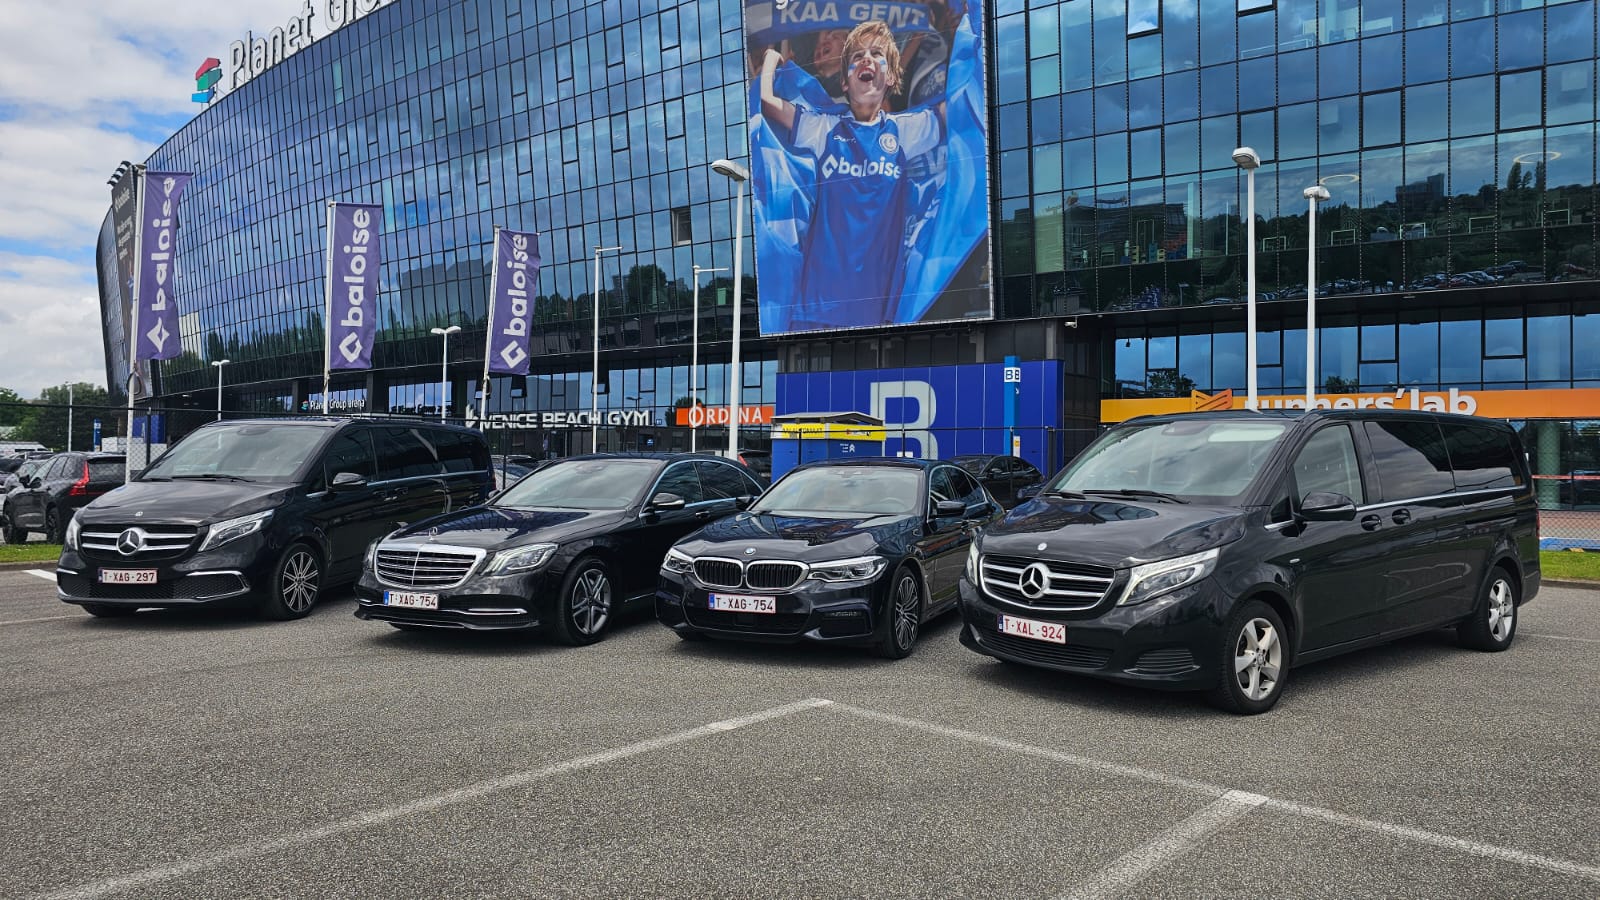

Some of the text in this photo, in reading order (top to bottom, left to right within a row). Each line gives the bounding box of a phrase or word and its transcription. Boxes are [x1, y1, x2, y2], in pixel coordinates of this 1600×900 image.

[780, 2, 839, 24] KAA
[850, 3, 926, 28] GENT
[230, 0, 314, 90] Planet
[838, 156, 902, 180] baloise
[151, 177, 176, 312] baloise
[340, 207, 371, 327] baloise
[503, 233, 529, 337] baloise
[1411, 387, 1477, 416] lab
[484, 410, 650, 429] VENICE BEACH GYM
[688, 406, 764, 427] ORDNA
[869, 380, 939, 460] B
[103, 571, 155, 582] T-XAG-297
[389, 593, 436, 607] T-XAG-754
[715, 597, 773, 611] T-XAG-754
[1004, 618, 1063, 641] T-XAL-924
